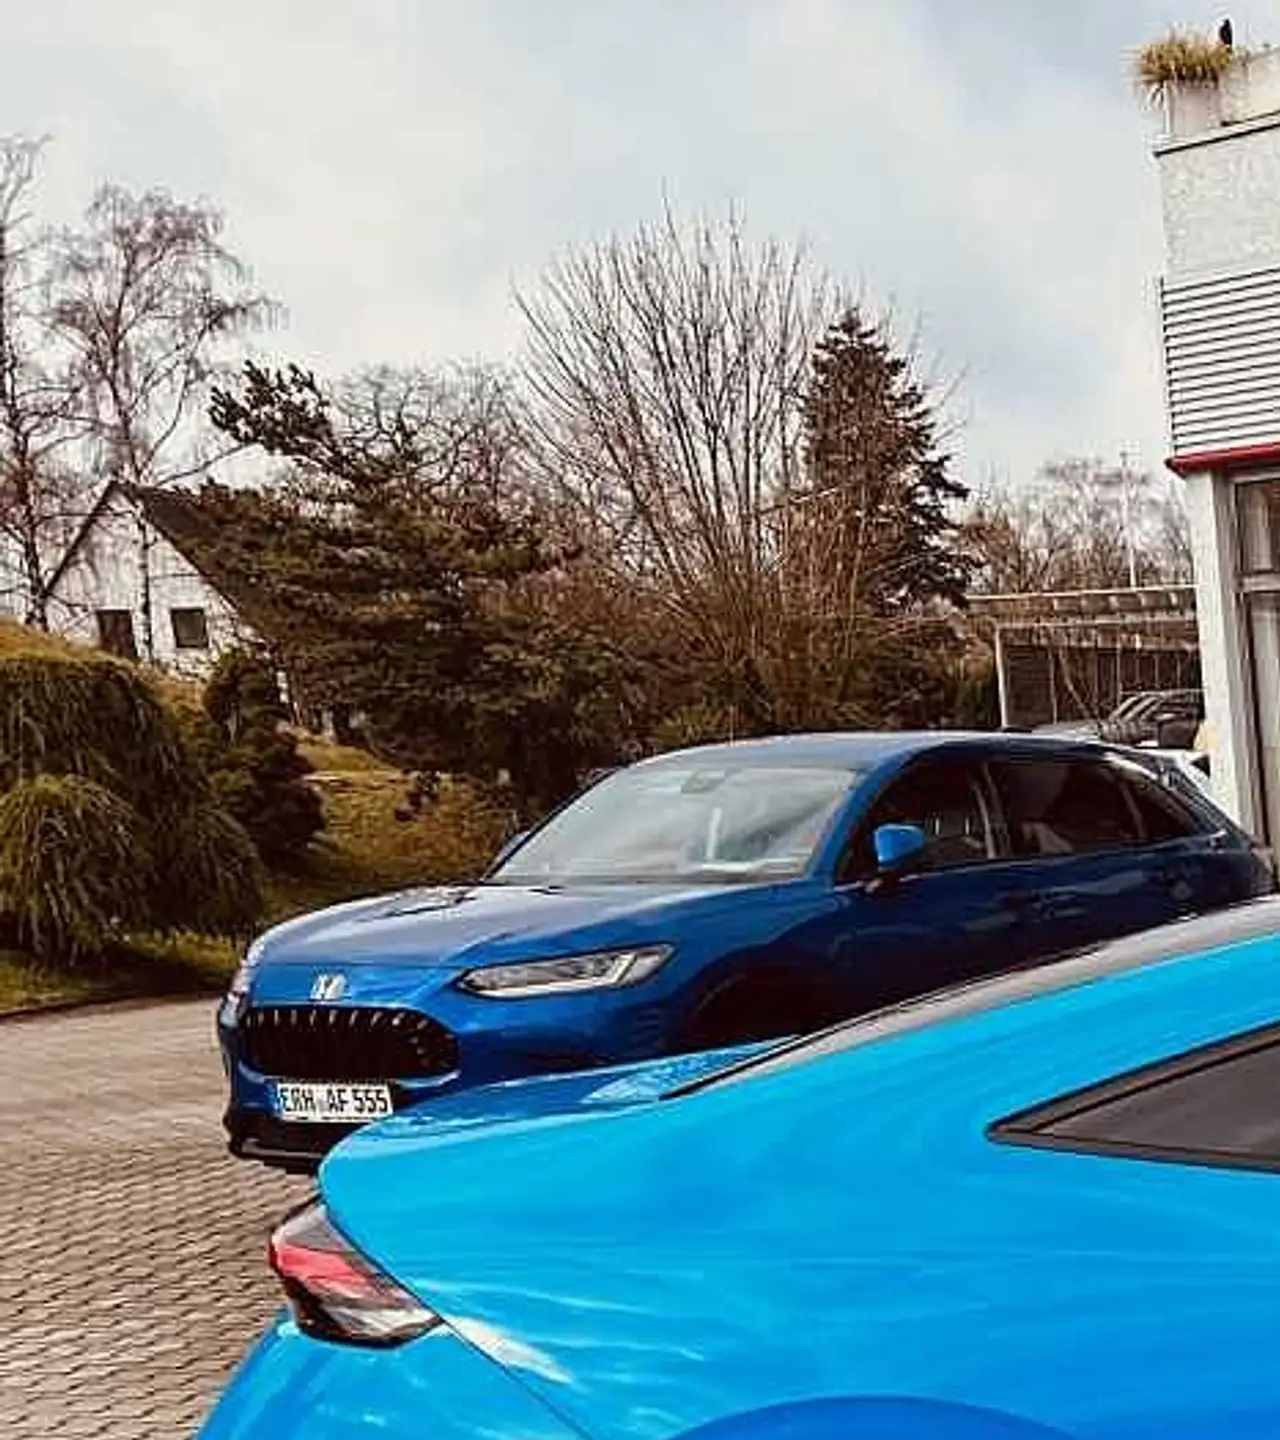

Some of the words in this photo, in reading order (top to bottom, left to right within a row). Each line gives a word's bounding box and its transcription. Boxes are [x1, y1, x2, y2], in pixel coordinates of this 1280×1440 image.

[280, 1087, 317, 1113] ERH
[327, 1088, 348, 1112] AF
[351, 1088, 389, 1113] 555
